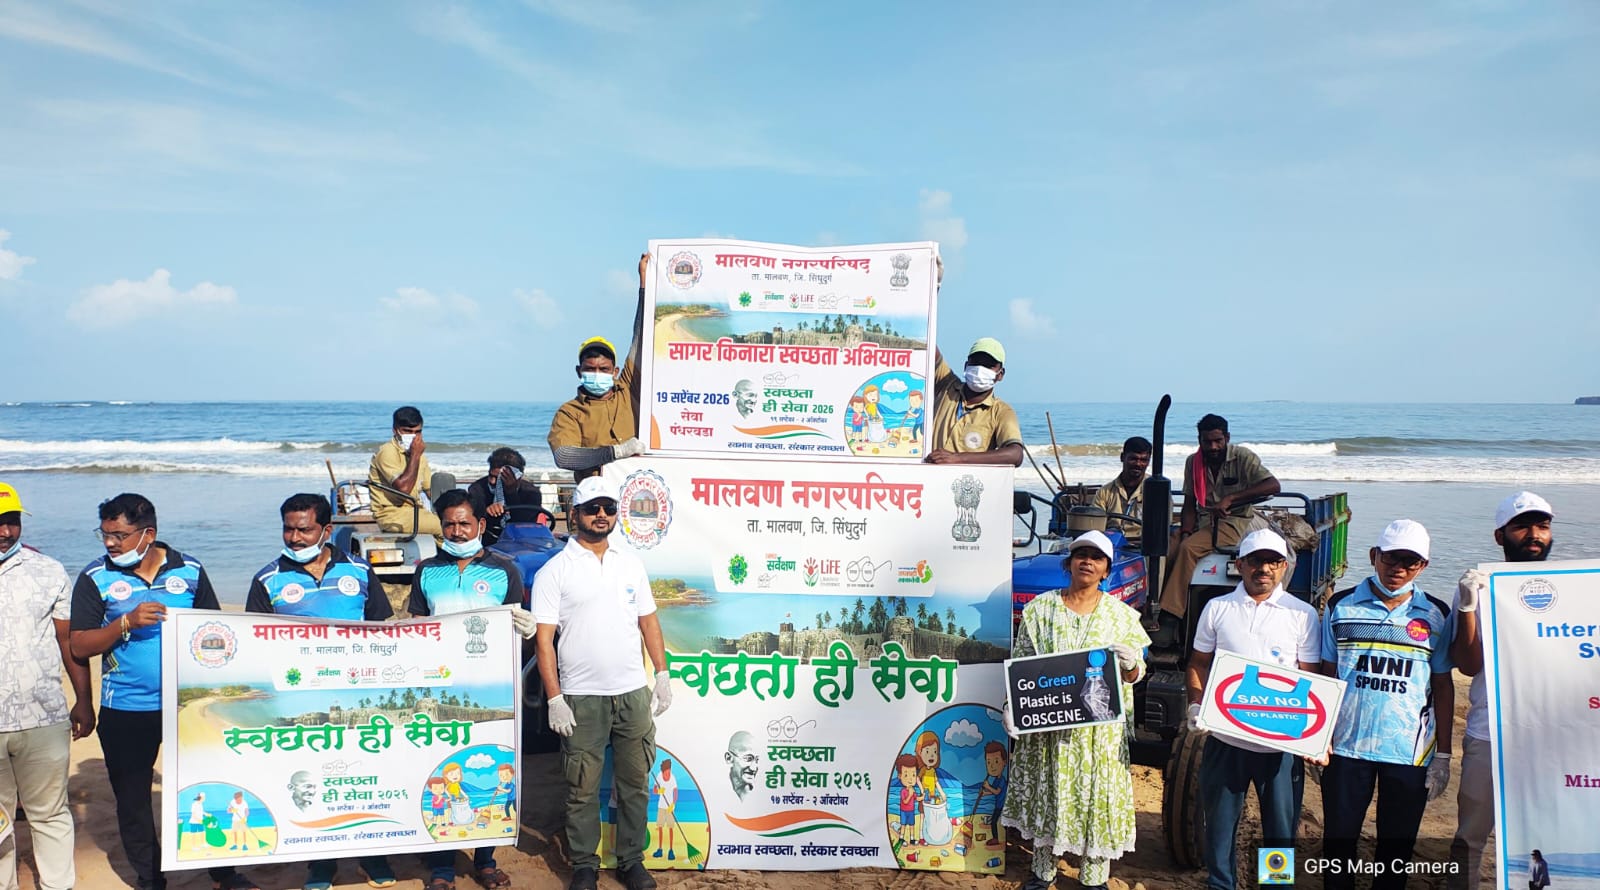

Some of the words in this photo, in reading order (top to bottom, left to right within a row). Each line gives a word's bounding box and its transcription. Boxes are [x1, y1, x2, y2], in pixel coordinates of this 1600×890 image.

[715, 254, 777, 269] मालवण
[668, 342, 713, 361] सागर
[716, 339, 775, 363] किनारा
[778, 345, 838, 365] स्वच्छता
[843, 343, 913, 368] अभियान
[656, 391, 669, 403] 19
[703, 393, 730, 405] 2026
[763, 388, 814, 399] स्वच्छता
[680, 407, 704, 422] सेवा
[762, 399, 778, 413] ही
[781, 400, 809, 413] सेवा
[812, 404, 834, 414] 2026
[670, 422, 714, 437] पंधरवडा
[691, 478, 785, 508] मालवण
[792, 471, 924, 519] नगरपरिषद
[747, 519, 762, 534] ता.
[766, 519, 806, 537] मालवण,
[811, 516, 828, 535] जि.
[832, 517, 867, 540] सिंधुदुर्ग
[766, 557, 797, 572] सर्वेक्षण
[821, 559, 841, 575] LiFE
[253, 624, 329, 640] मालवण
[1536, 622, 1600, 638] Inter
[812, 641, 859, 707] ही
[870, 642, 958, 702] सेवा
[1356, 655, 1413, 678] AVNI
[1017, 678, 1036, 691] Go
[1038, 674, 1077, 689] Green
[1355, 675, 1408, 694] SPORTS
[1020, 692, 1060, 710] Plastic
[1062, 692, 1073, 704] is
[1237, 694, 1269, 705] SAY
[1274, 696, 1302, 707] NO
[1021, 708, 1086, 728] OBSCENE.
[1260, 712, 1300, 720] PLASTIC
[224, 725, 346, 755] स्वछता
[356, 714, 394, 753] ही
[404, 713, 473, 748] सेवा
[767, 746, 836, 762] स्वच्छता
[322, 775, 378, 787] स्वच्छता
[765, 764, 787, 789] ही
[791, 766, 829, 788] सेवा
[833, 772, 872, 790] २०२६
[322, 788, 338, 803] ही
[343, 788, 373, 801] सेवा
[812, 796, 818, 806] २
[717, 844, 752, 856] स्वभाव
[801, 841, 838, 857] संस्कार
[840, 846, 880, 857] स्वच्छता
